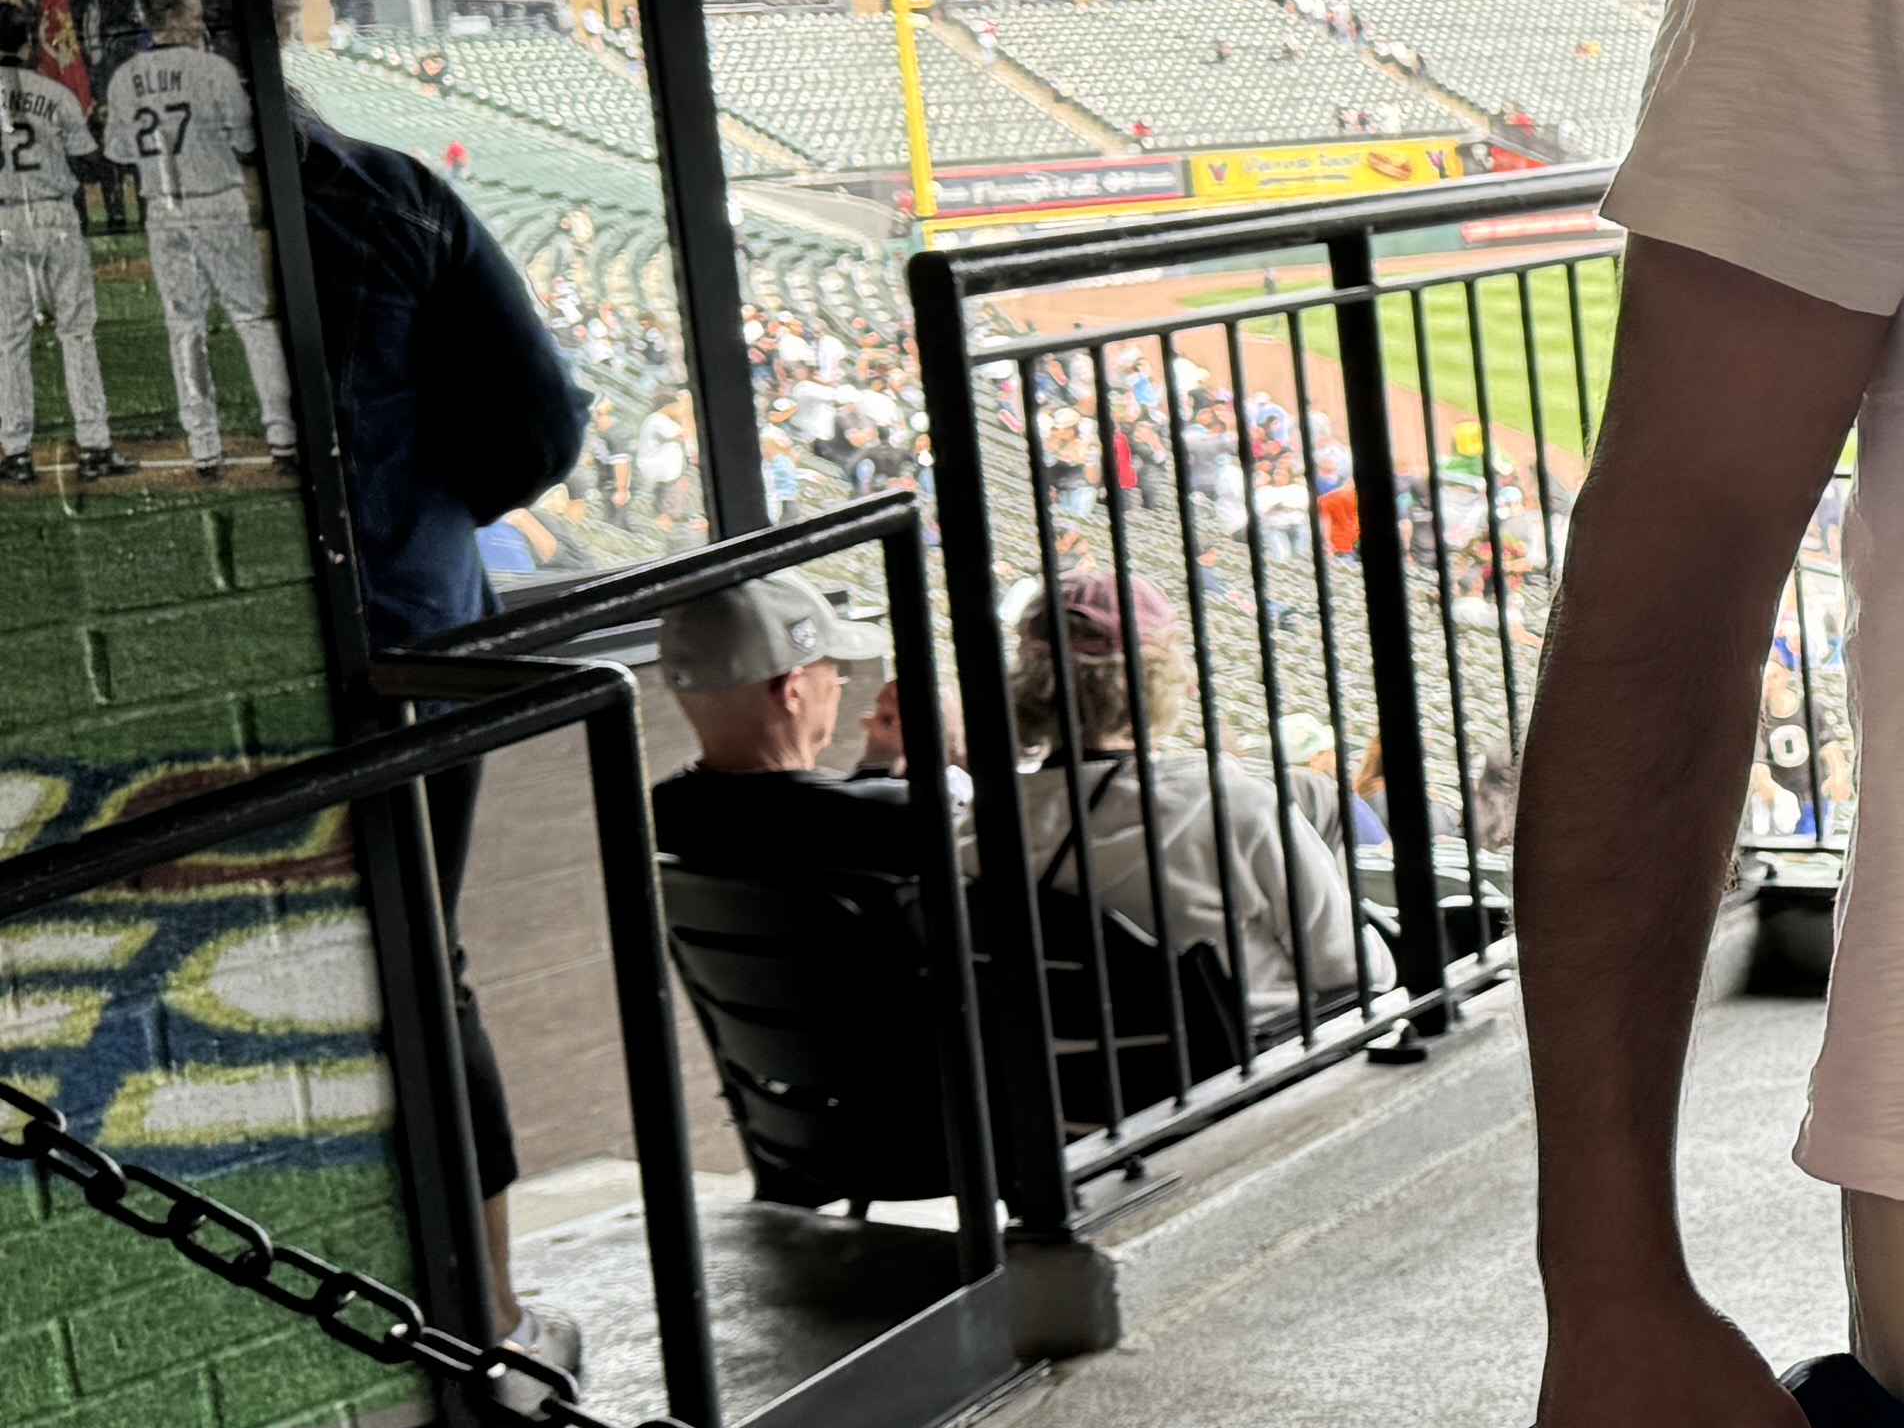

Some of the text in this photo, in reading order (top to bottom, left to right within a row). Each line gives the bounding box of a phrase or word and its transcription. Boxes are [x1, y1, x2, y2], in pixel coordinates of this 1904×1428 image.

[132, 70, 183, 99] BLUM
[0, 123, 41, 173] 2
[133, 100, 192, 158] 27
